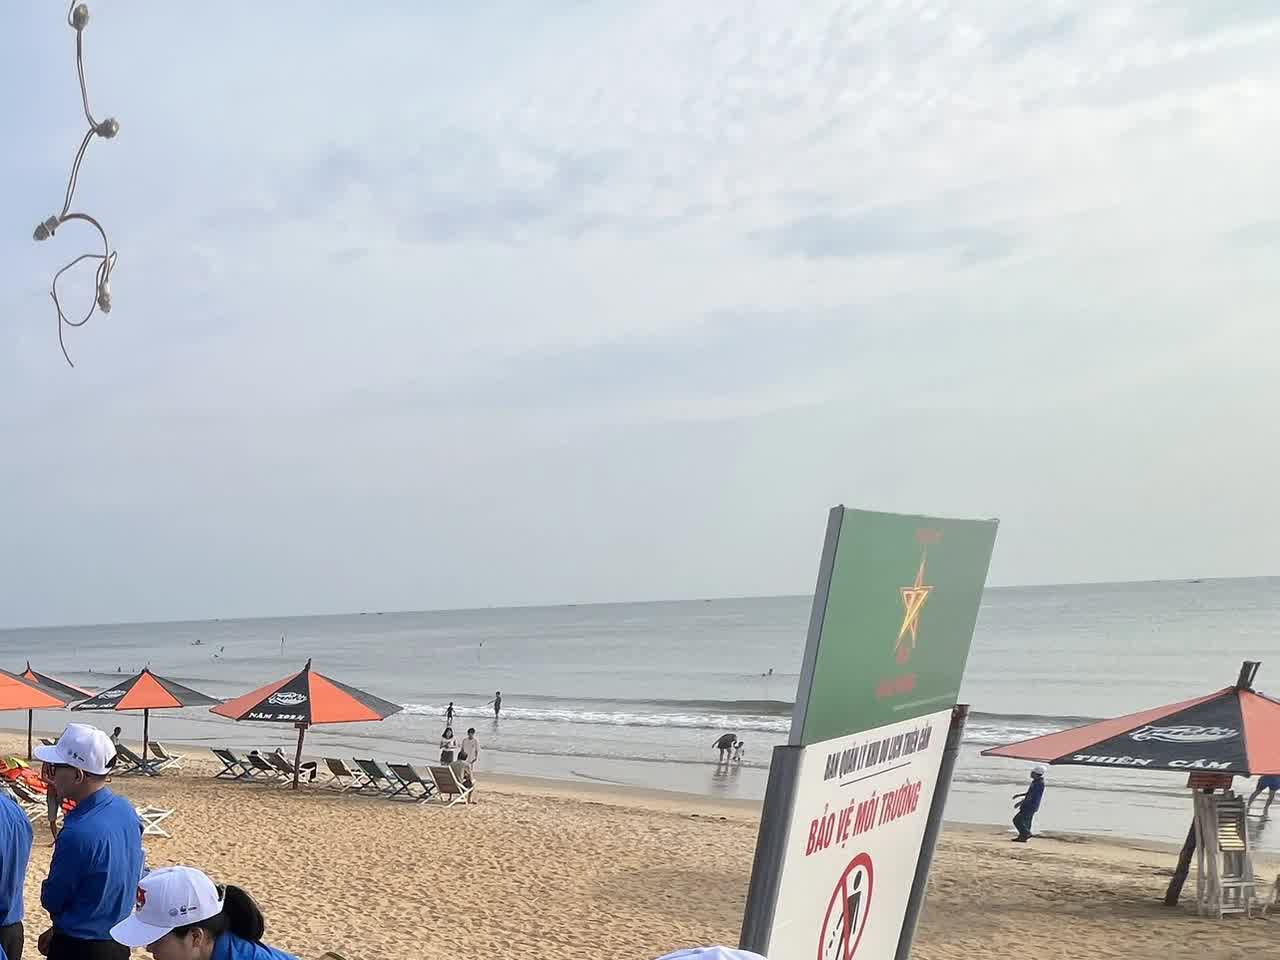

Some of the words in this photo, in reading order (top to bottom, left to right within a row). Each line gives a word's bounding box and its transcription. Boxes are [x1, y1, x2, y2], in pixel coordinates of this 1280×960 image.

[824, 752, 841, 781] BAN
[806, 803, 836, 856] BẢO
[836, 798, 855, 849] VỆ
[852, 790, 880, 837] MÔI
[878, 777, 922, 827] TRƯỜNG
